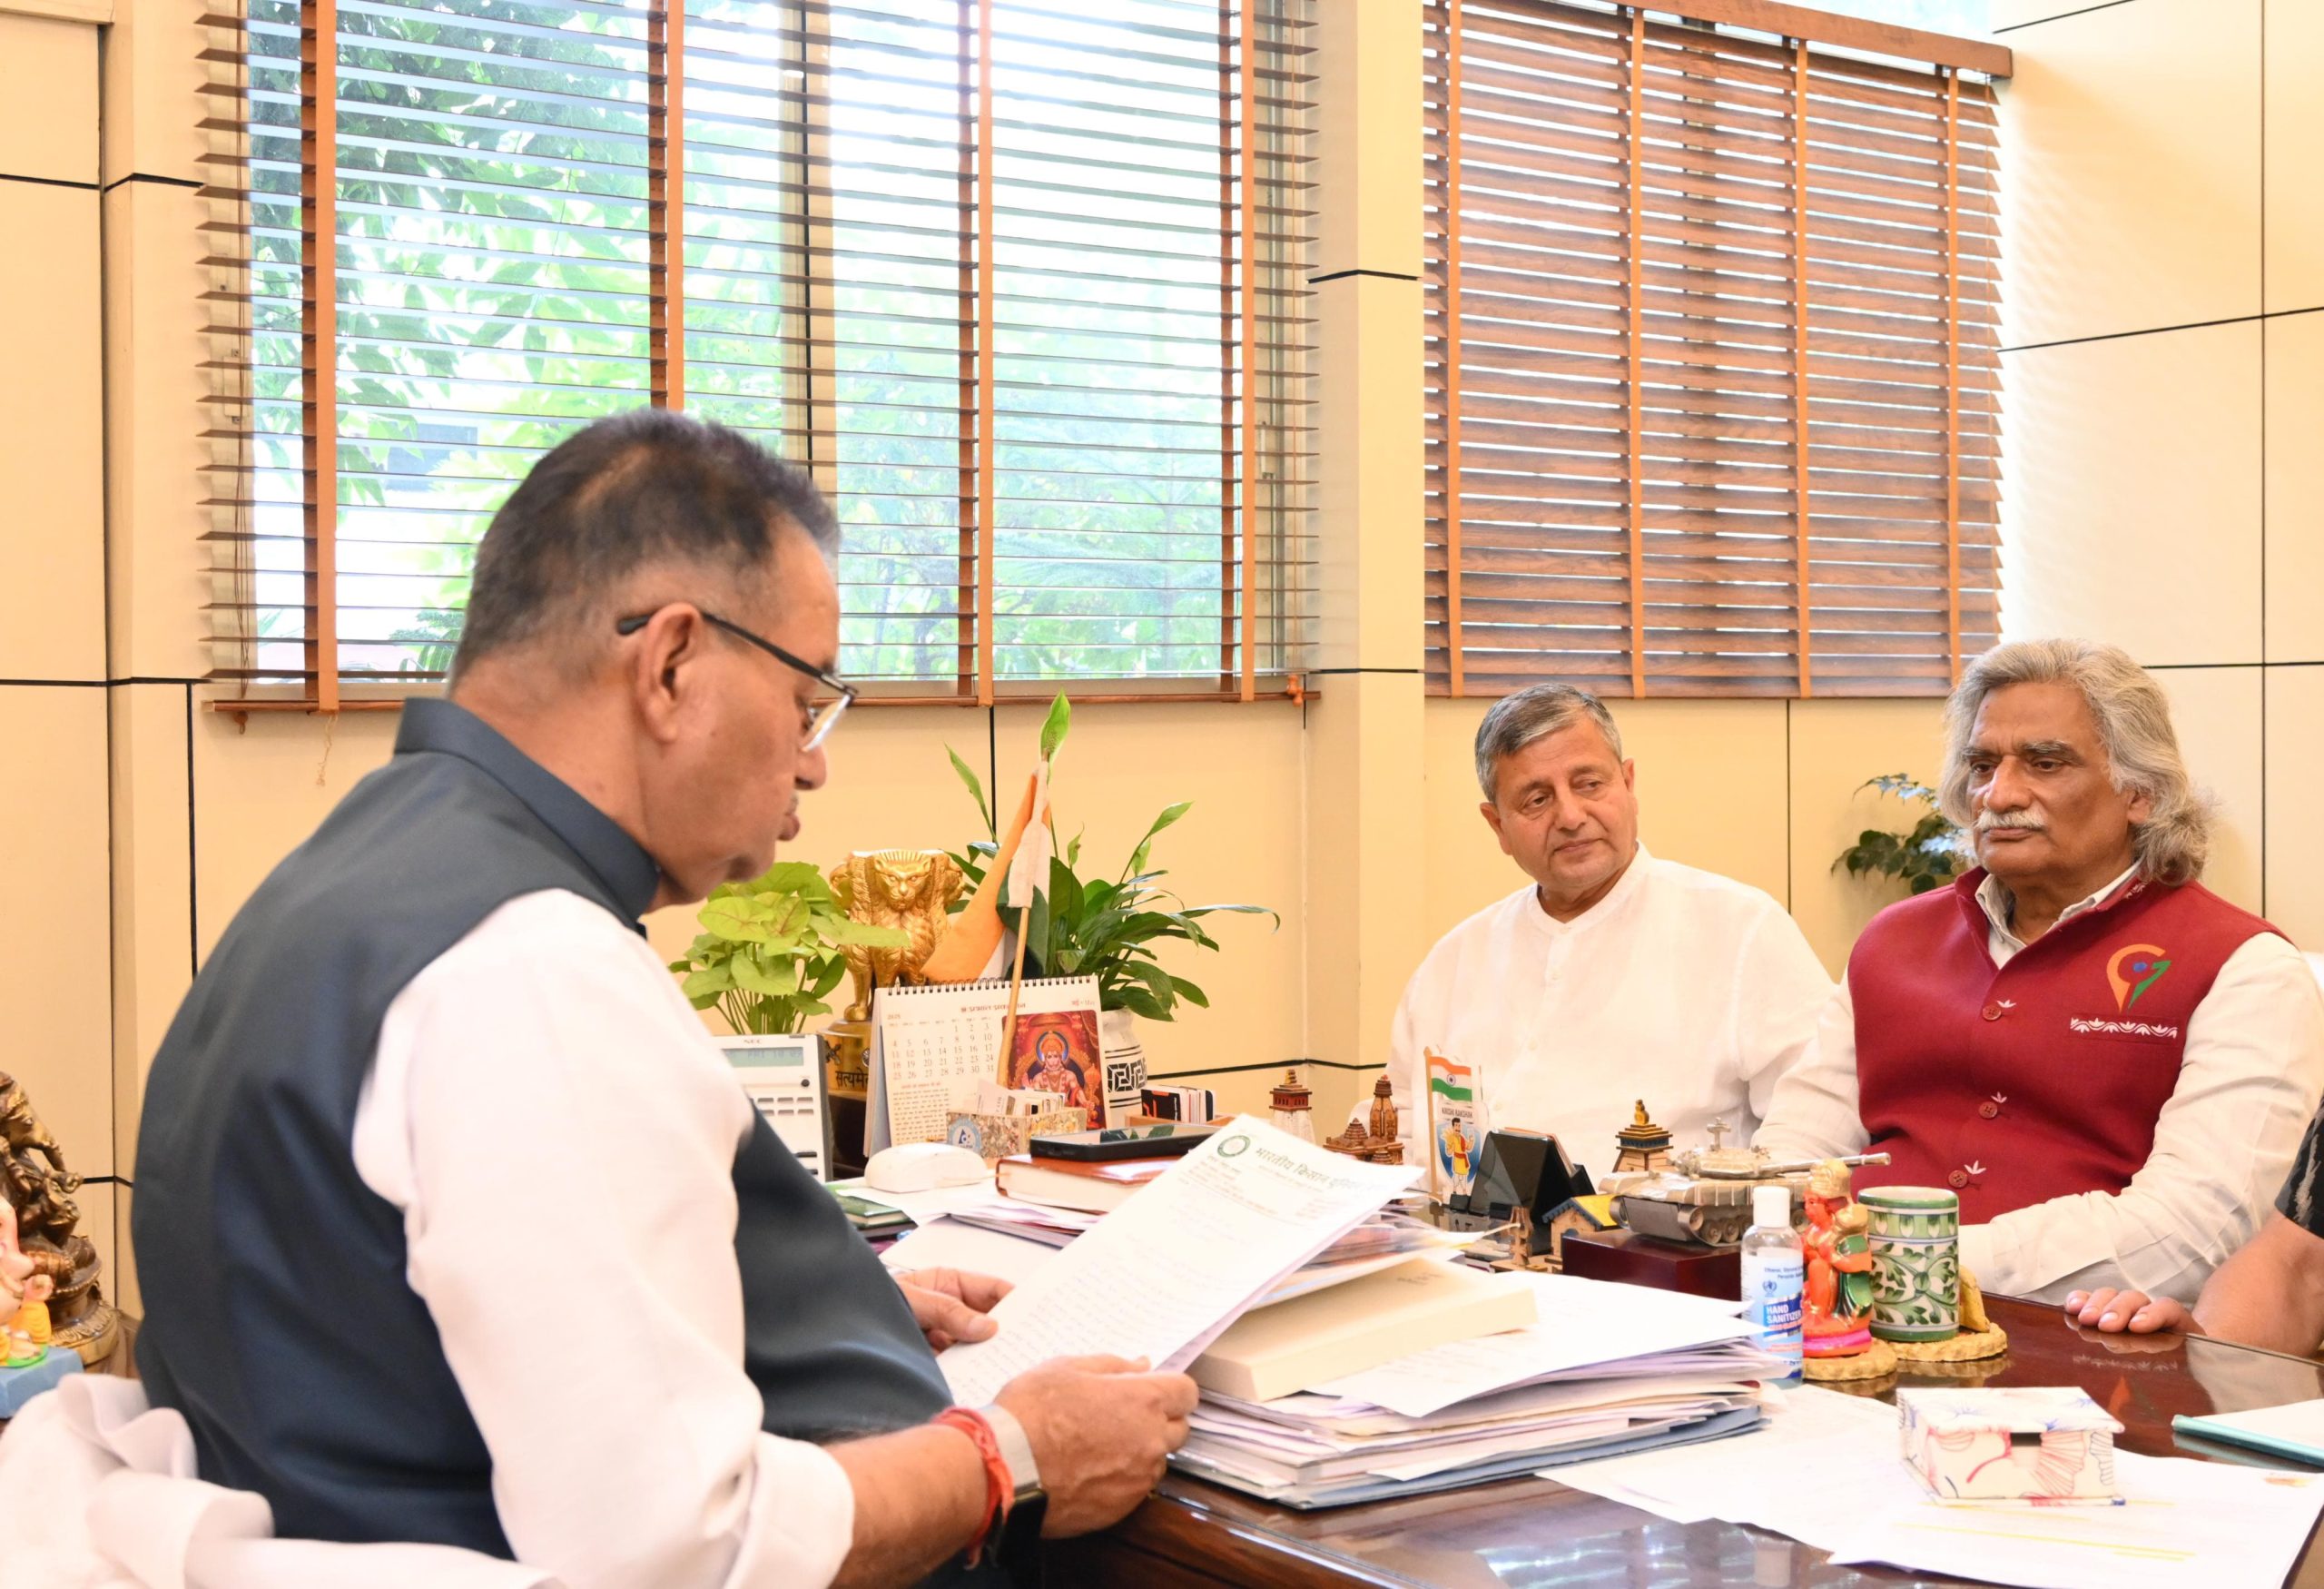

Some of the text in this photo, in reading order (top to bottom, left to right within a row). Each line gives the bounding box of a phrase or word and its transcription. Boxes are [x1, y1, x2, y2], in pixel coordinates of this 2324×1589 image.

[907, 1050, 915, 1058] 12
[1256, 1148, 1295, 1170] भारतीय
[1293, 1163, 1330, 1183] किसान
[1767, 1304, 1788, 1314] HAND
[1767, 1309, 1802, 1324] SANITIZER
